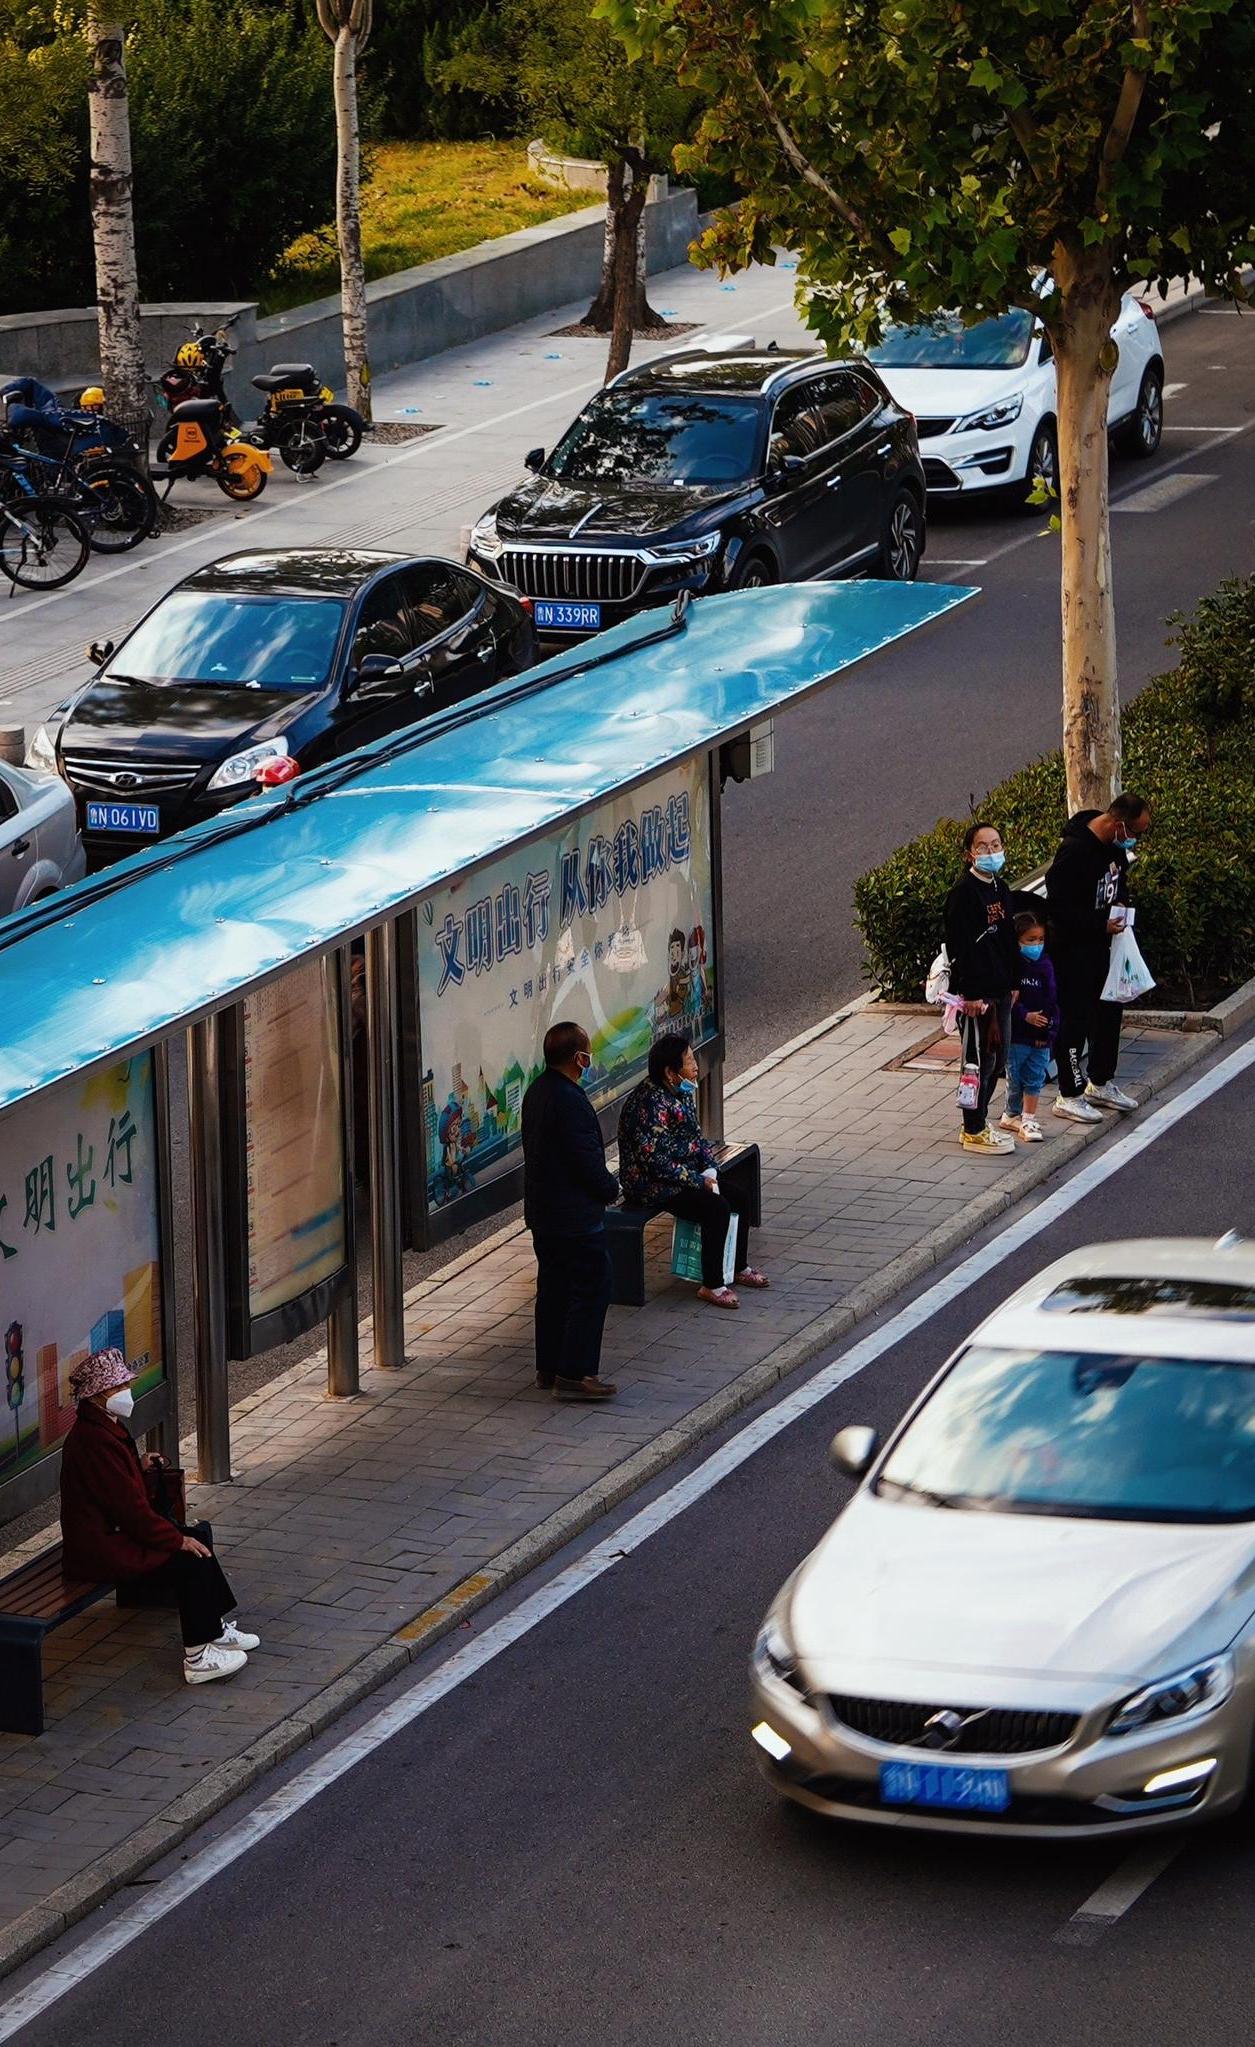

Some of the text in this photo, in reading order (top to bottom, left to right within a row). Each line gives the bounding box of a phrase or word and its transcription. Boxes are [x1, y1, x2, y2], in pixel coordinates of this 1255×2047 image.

[434, 790, 691, 998] 文明出行 从你我做起
